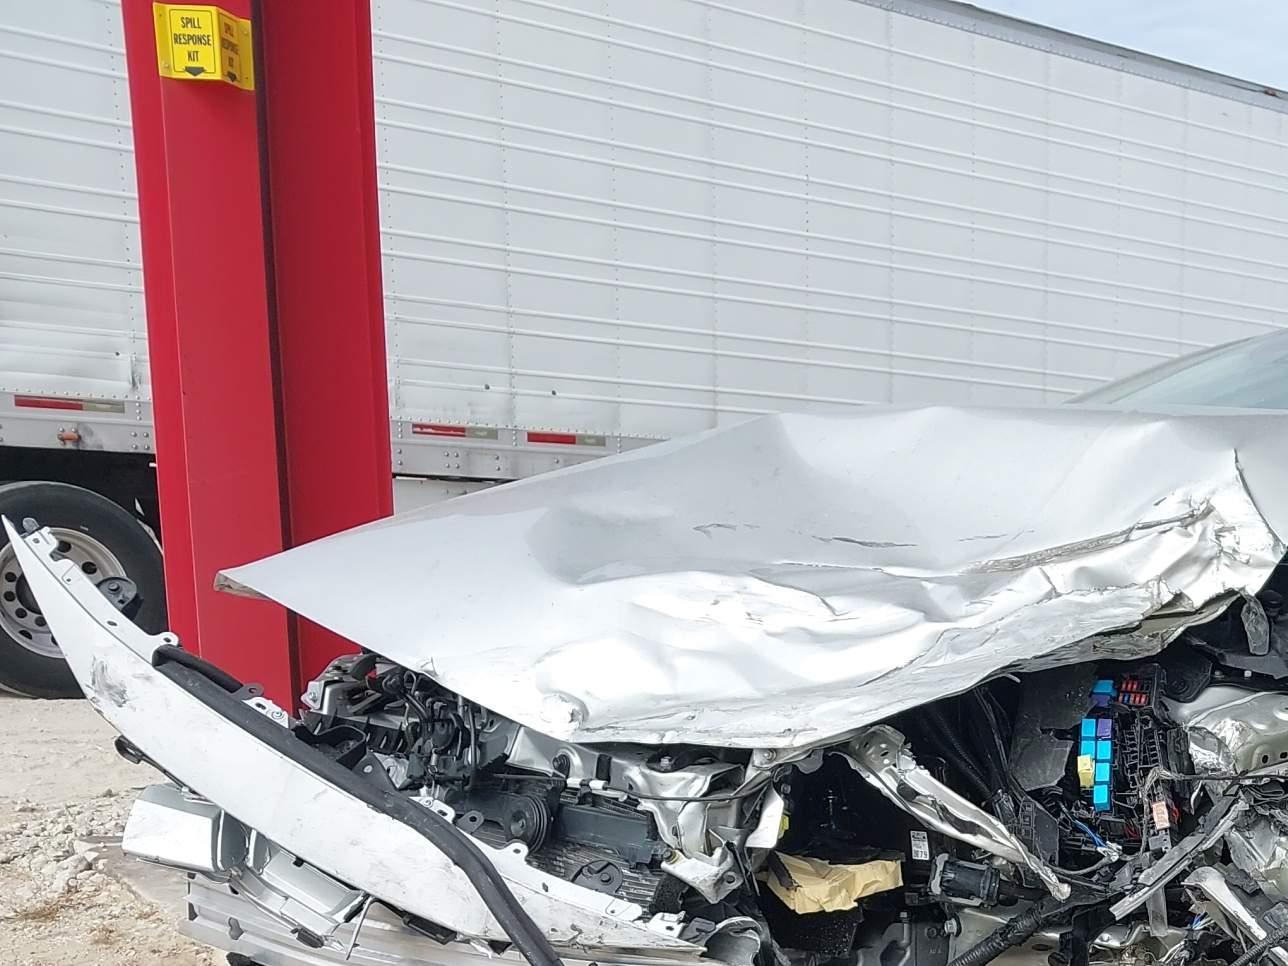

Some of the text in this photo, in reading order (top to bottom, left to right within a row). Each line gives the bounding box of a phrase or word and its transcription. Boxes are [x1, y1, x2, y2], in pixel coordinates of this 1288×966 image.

[180, 16, 202, 29] SPILL
[173, 33, 212, 46] RESPONSE
[187, 50, 200, 62] KIT
